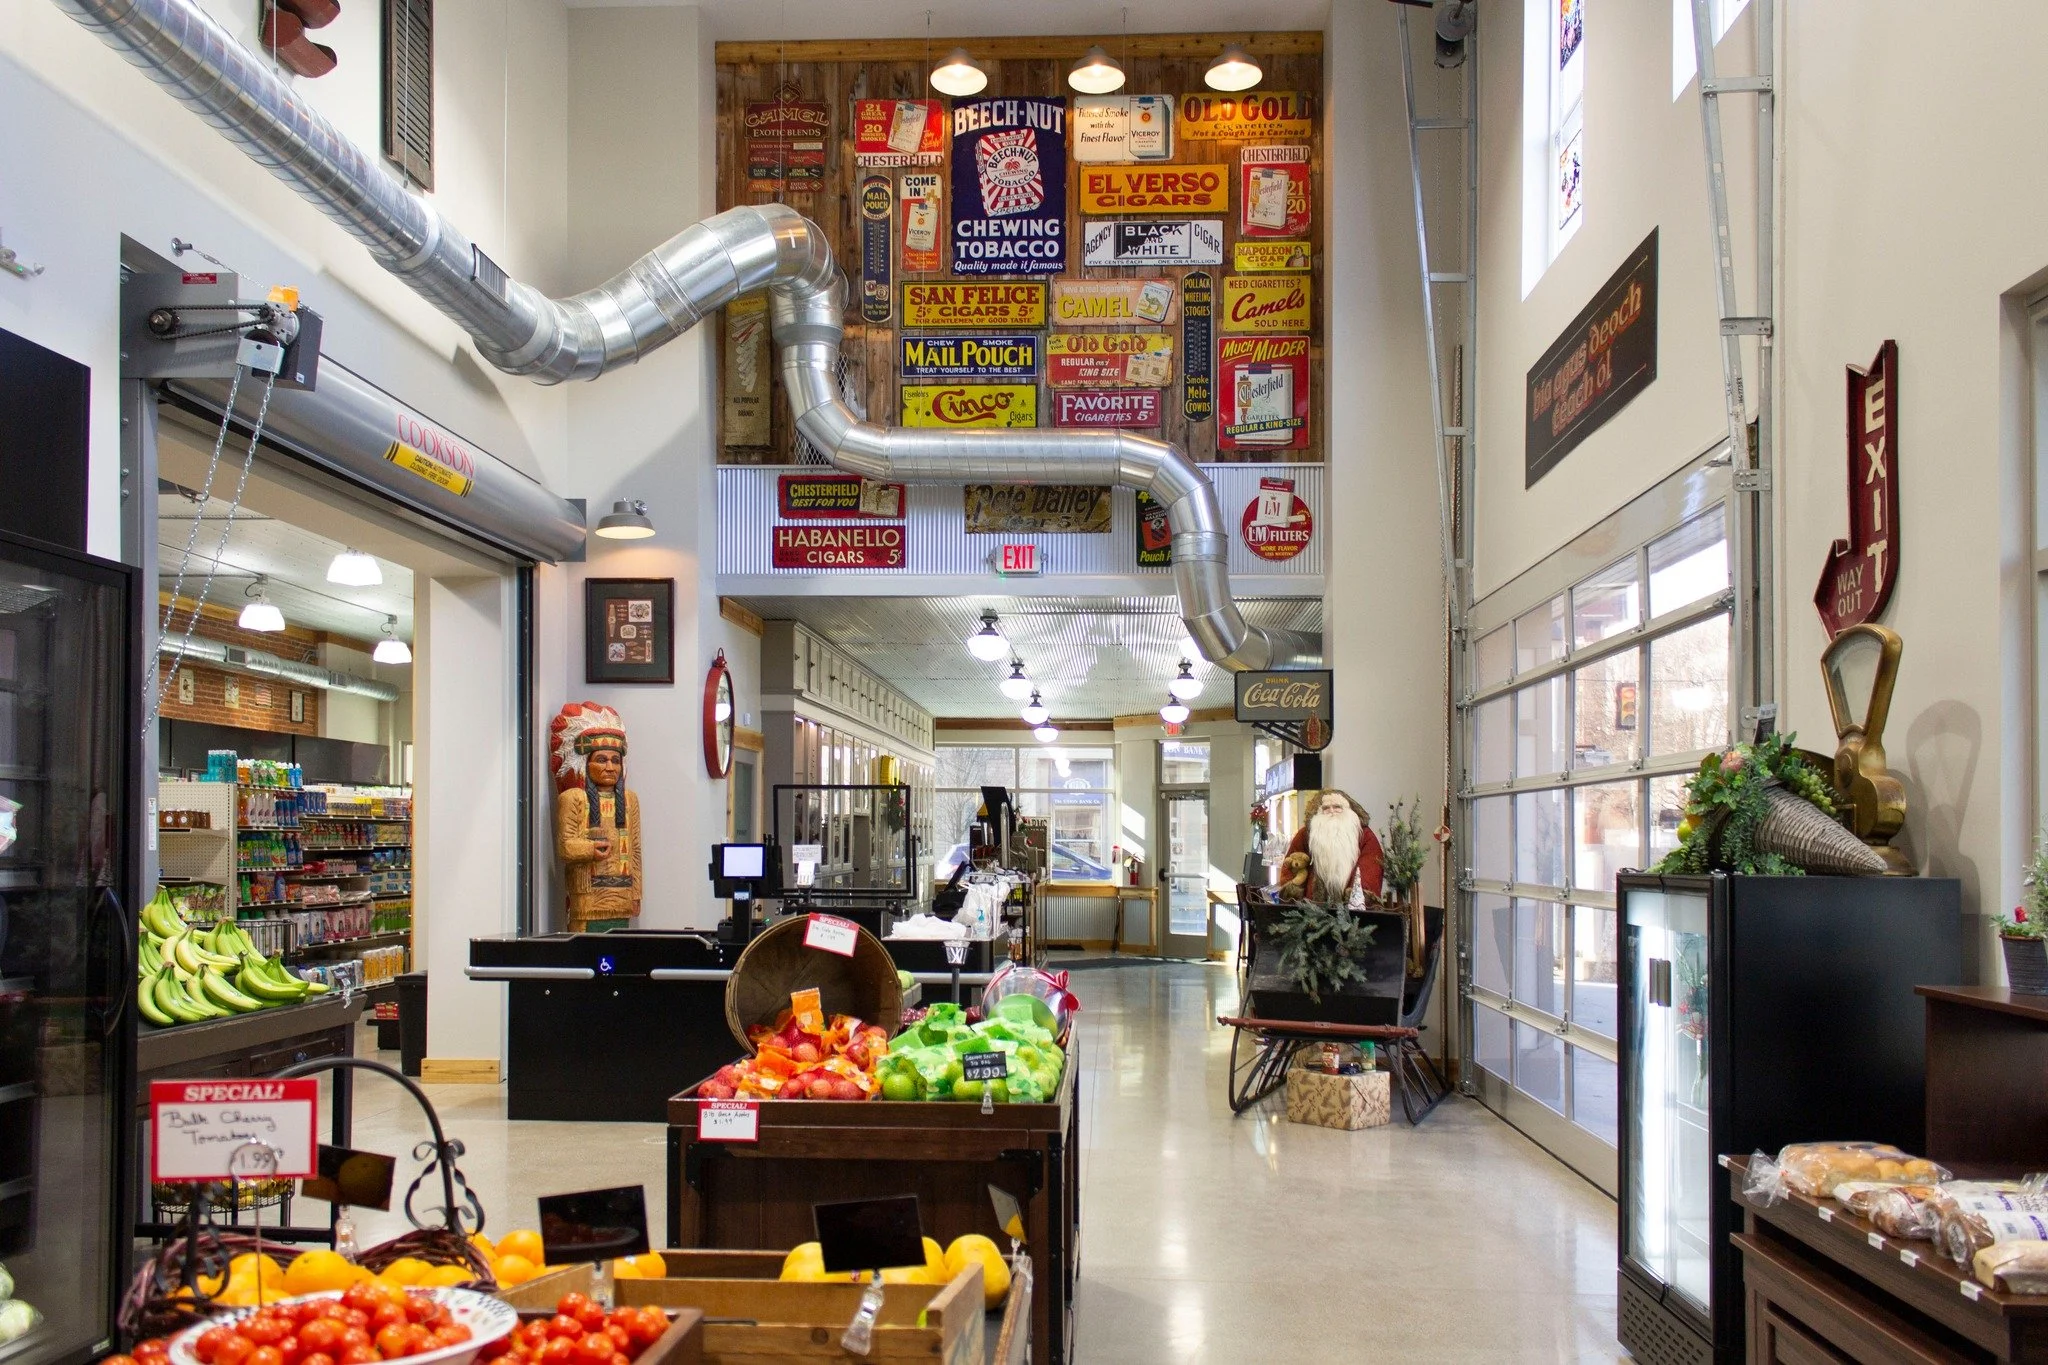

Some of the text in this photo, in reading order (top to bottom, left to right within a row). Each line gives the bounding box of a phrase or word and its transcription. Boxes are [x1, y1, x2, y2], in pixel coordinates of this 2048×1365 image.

[865, 103, 882, 112] 21
[1184, 94, 1312, 122] OLD GOLD
[745, 108, 830, 127] CAMEL
[954, 100, 1064, 137] BEECH-NUT
[753, 128, 821, 137] EXOTIC BLENDS
[864, 124, 882, 133] 20
[1131, 130, 1160, 138] VICEROY
[1080, 132, 1101, 142] Finest
[857, 155, 943, 166] CHESTERFIELD
[988, 147, 1036, 169] BEECH-NUT
[1242, 148, 1310, 162] CHESTERFIELD
[906, 176, 936, 186] COME
[993, 170, 1035, 186] TOBACCO
[1089, 172, 1220, 194] EL VERSO
[1287, 181, 1304, 196] 21
[867, 192, 888, 200] MAIL
[1096, 194, 1212, 207] CIGARS
[865, 200, 888, 210] POUCH
[1287, 198, 1306, 214] 20
[908, 228, 931, 236] VICEROY
[957, 218, 1060, 238] CHEWING
[1125, 226, 1182, 236] BLACK
[1085, 224, 1112, 258] AGENCY
[1194, 224, 1220, 254] CIGAR
[956, 240, 1060, 258] TOBACCO
[1128, 245, 1179, 255] WHITE
[1238, 246, 1292, 256] NAPOLEON
[954, 260, 1064, 273] Quality made it famous
[1185, 278, 1210, 289] POLLACK
[1229, 280, 1248, 288] NEED
[910, 286, 1040, 305] SAN FELICE
[1185, 292, 1210, 302] WHEELING
[938, 306, 1010, 316] CIGARS
[1058, 294, 1133, 318] CAMEL
[1185, 305, 1210, 316] STOGIES
[1232, 288, 1304, 322] Camels
[1254, 320, 1278, 328] SOLD
[1067, 335, 1148, 353] Old Gold
[906, 341, 1032, 366] MAIL POUCH
[1222, 340, 1306, 363] MUCH MILDER
[1061, 358, 1095, 366] REGULAR
[1079, 368, 1120, 376] KING SIZE
[1187, 387, 1210, 398] Melo-
[932, 388, 1015, 424] Cinco
[1060, 394, 1155, 422] FAVORITE
[1185, 400, 1210, 414] Crowns
[1010, 411, 1034, 423] Cigars
[1075, 412, 1132, 422] CIGARETTES
[1266, 418, 1302, 428] KING-SIZE
[398, 414, 474, 478] COOKSON
[790, 484, 859, 498] CHESTERFIELD
[1865, 379, 1887, 592] EXIT
[792, 498, 857, 507] BEST FOR YOU
[780, 529, 900, 548] HABANELLO
[1270, 530, 1309, 542] FILTERS
[806, 550, 864, 564] CIGARS
[887, 550, 902, 565] 5¢
[1003, 546, 1035, 570] EXIT
[1140, 550, 1166, 562] Pouch
[1836, 563, 1864, 596] WAY
[1838, 589, 1863, 618] OUT
[1243, 682, 1322, 708] Coca-Cola
[1183, 746, 1203, 755] BANK
[184, 1082, 286, 1102] SPECIAL!
[711, 1102, 748, 1110] SPECIAL!
